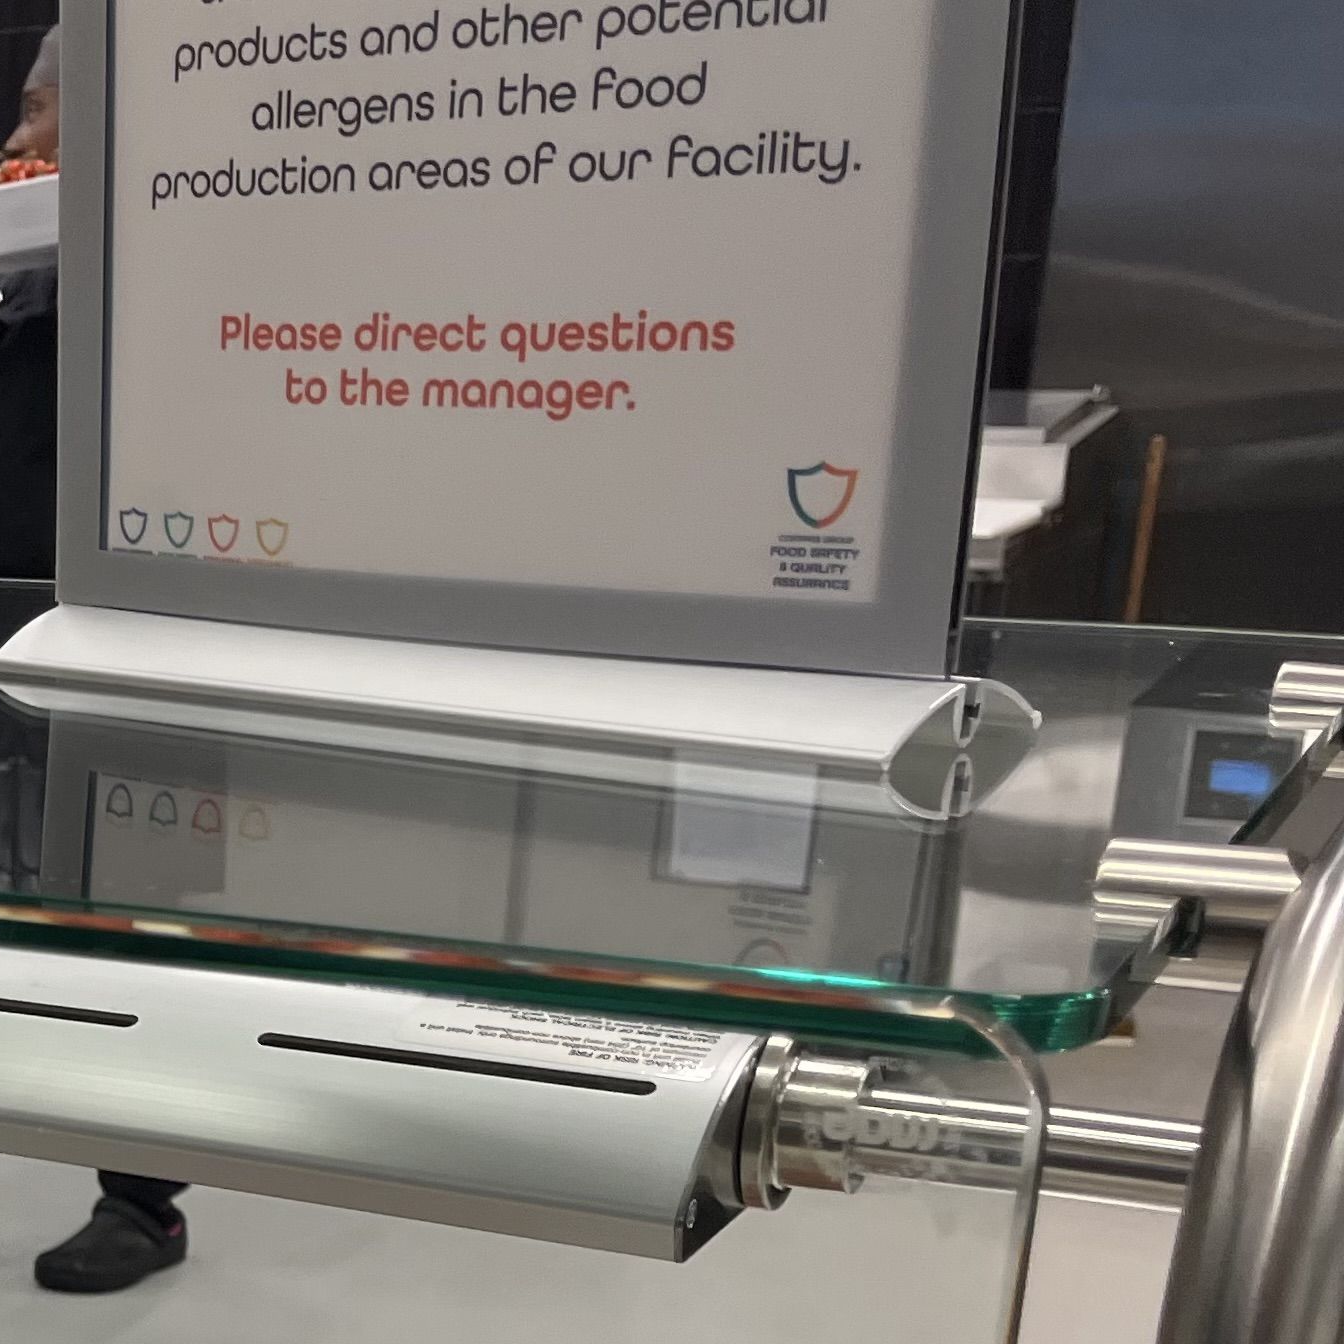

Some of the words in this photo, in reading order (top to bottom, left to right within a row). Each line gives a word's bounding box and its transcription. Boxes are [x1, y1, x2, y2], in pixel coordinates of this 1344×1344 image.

[175, 22, 347, 82] products
[360, 10, 439, 56] and
[452, 3, 583, 49] other
[252, 89, 434, 137] allergens
[449, 78, 483, 119] in
[498, 73, 576, 116] the
[592, 60, 707, 111] food
[152, 155, 355, 210] production
[368, 157, 490, 191] areas
[504, 141, 557, 185] of
[569, 149, 652, 183] our
[667, 130, 861, 185] facility.
[221, 313, 342, 351] Please
[354, 312, 486, 352] direct
[500, 310, 735, 362] questions
[286, 368, 327, 406] to
[340, 368, 409, 407] the
[423, 379, 635, 421] manager.
[770, 545, 806, 557] FOOD
